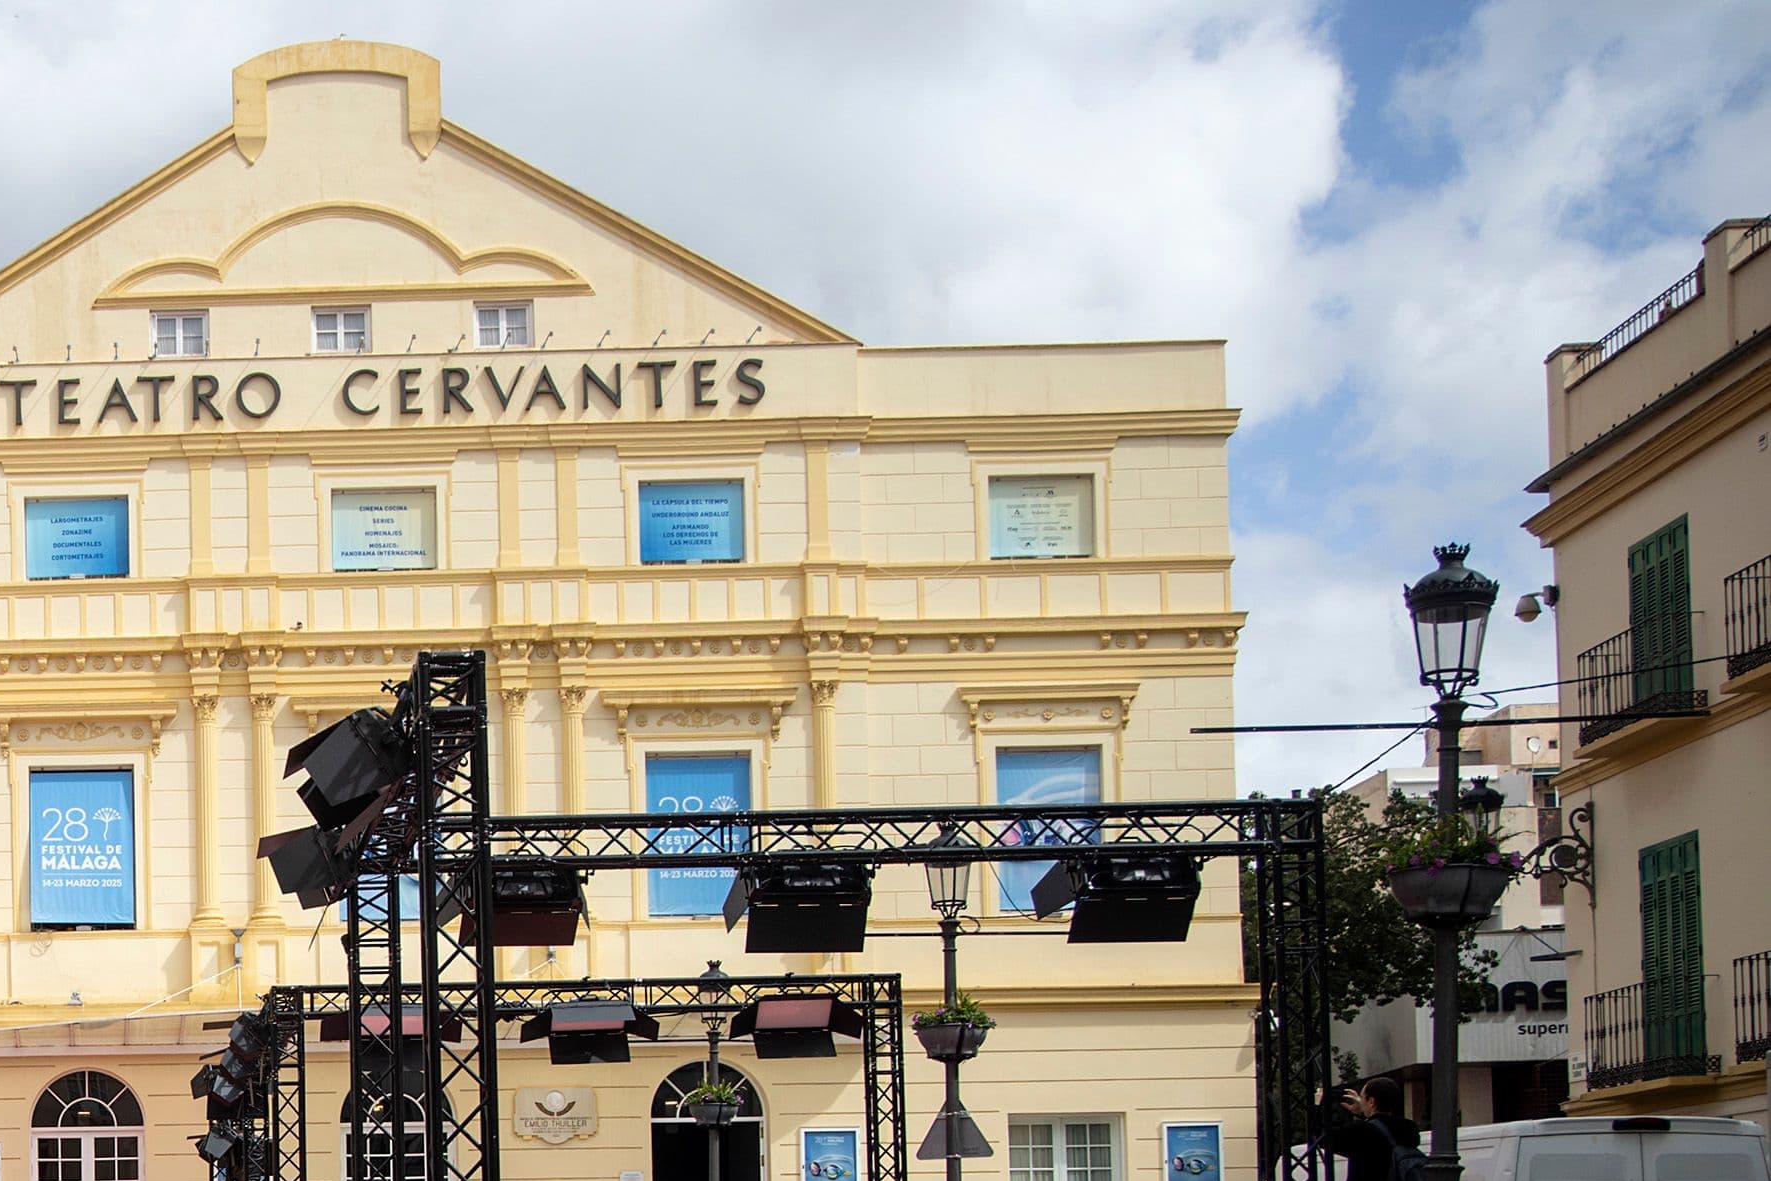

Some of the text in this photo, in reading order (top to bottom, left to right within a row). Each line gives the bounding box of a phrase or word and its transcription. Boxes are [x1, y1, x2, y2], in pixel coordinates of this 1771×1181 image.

[0, 358, 766, 426] TEATRO CERVANTES
[42, 807, 89, 842] 28
[41, 845, 122, 855] FESTIVAL DE
[41, 853, 122, 870] MÁLAGA
[683, 869, 718, 878] MARZO
[42, 878, 122, 887] 14-23 MARZO 2025
